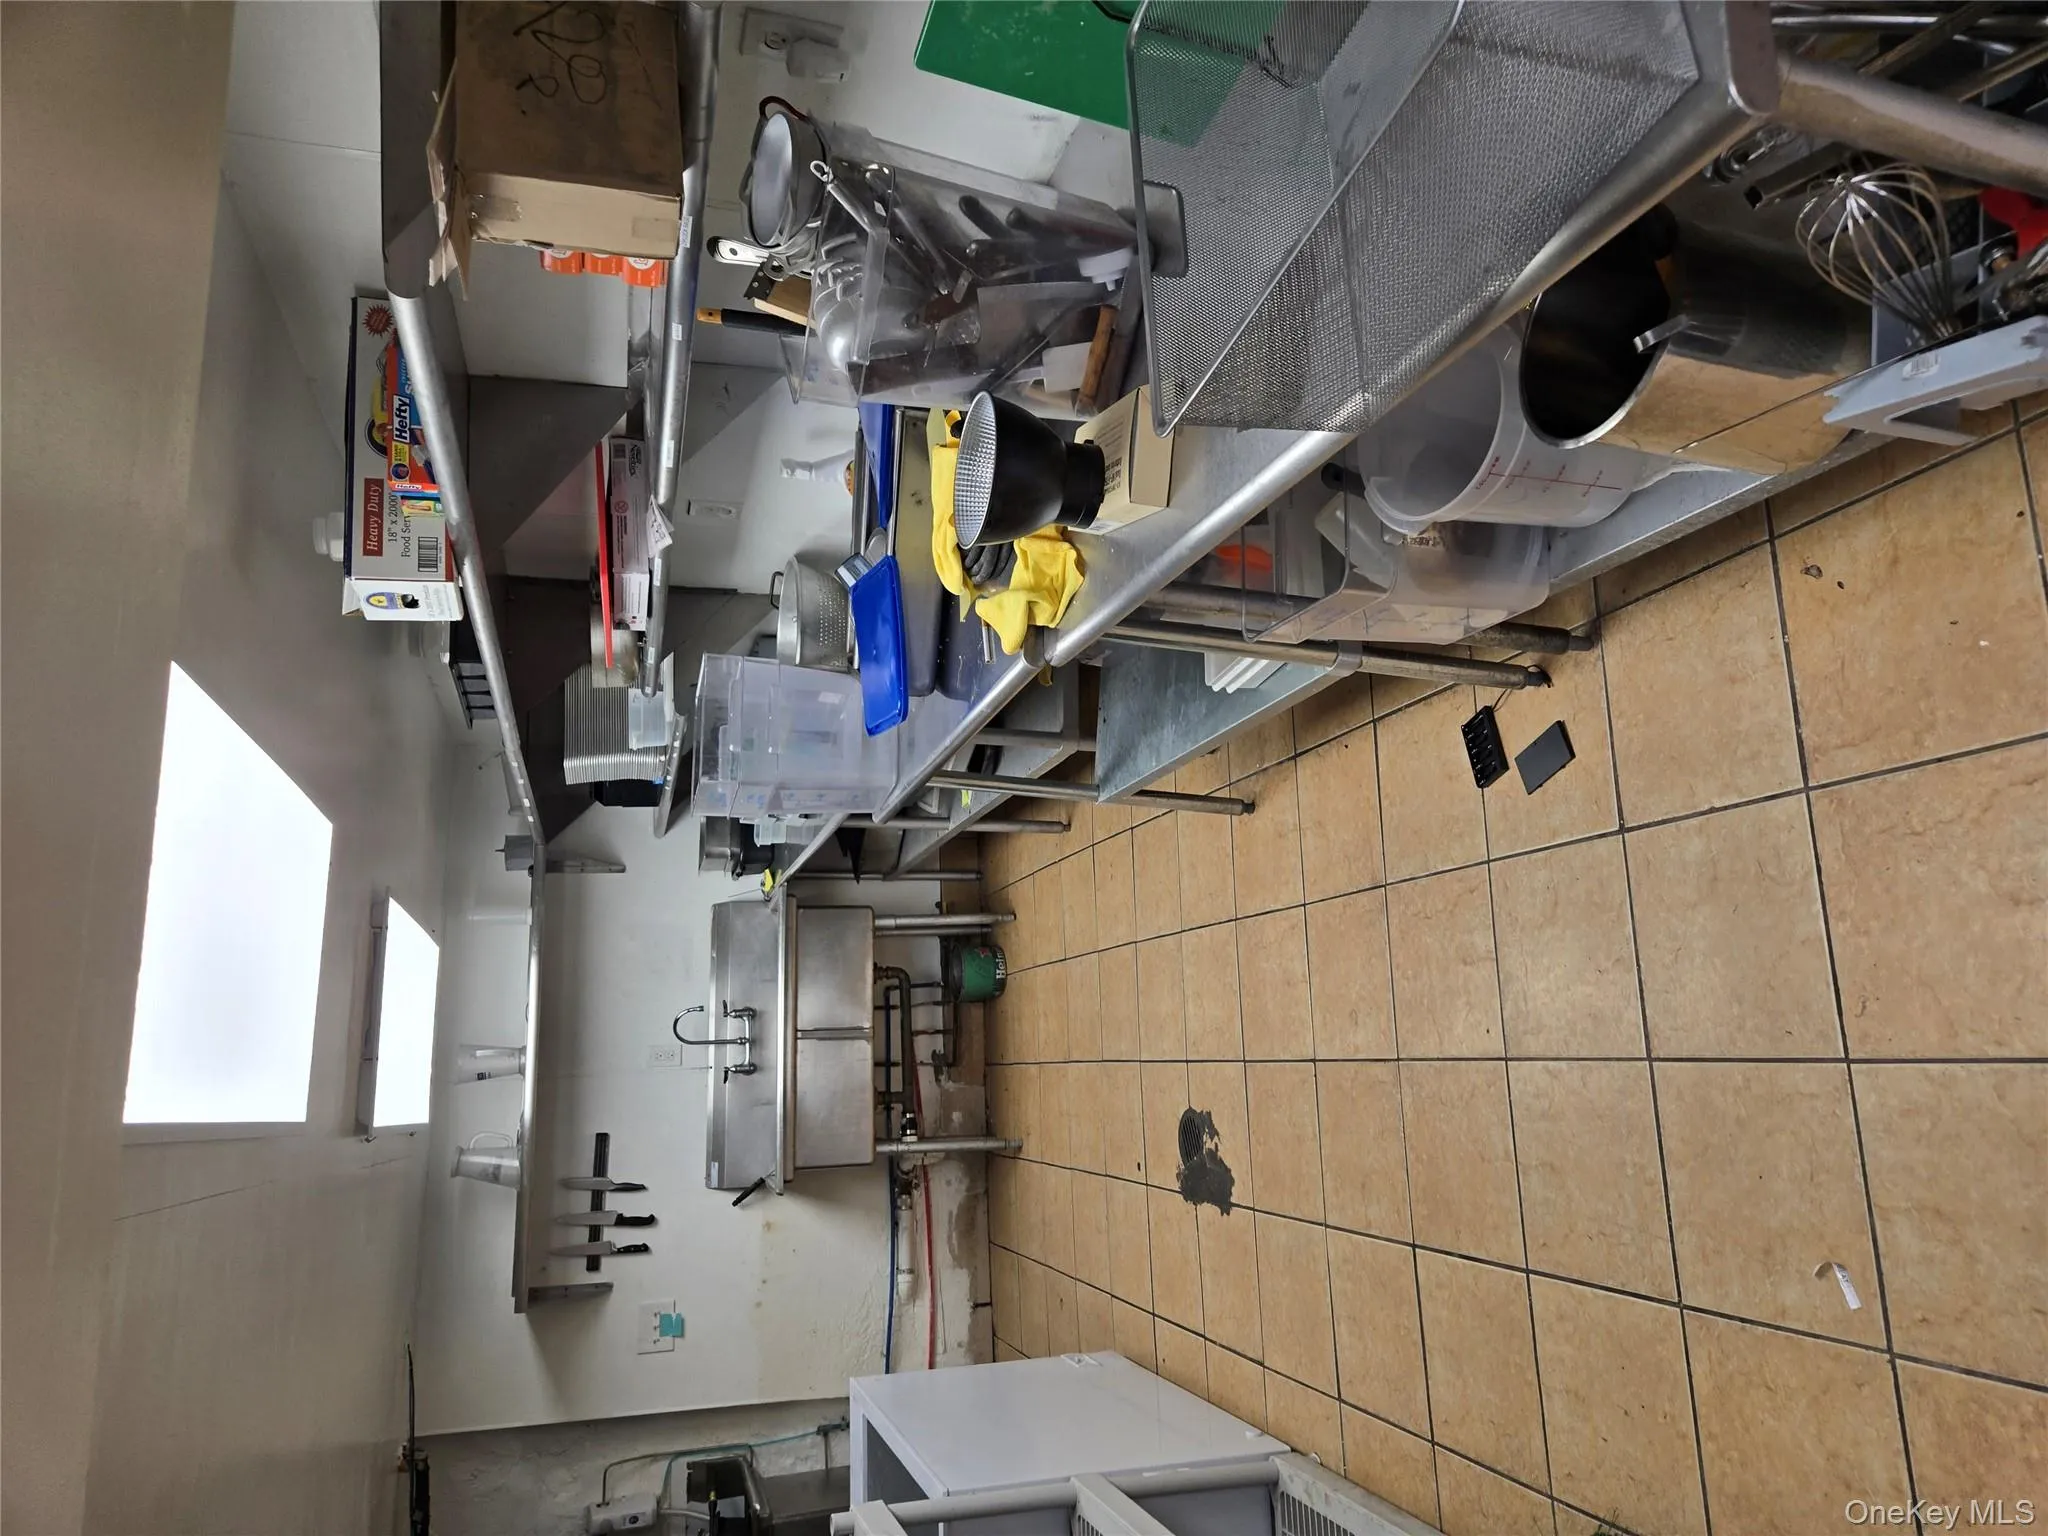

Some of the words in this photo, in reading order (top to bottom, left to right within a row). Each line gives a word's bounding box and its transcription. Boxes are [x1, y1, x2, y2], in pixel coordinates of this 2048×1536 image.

[394, 398, 409, 440] Hefty
[367, 484, 382, 512] Duty
[366, 514, 382, 550] Heavy
[387, 527, 398, 542] 18"
[400, 536, 411, 557] Food
[995, 949, 1006, 978] Hein
